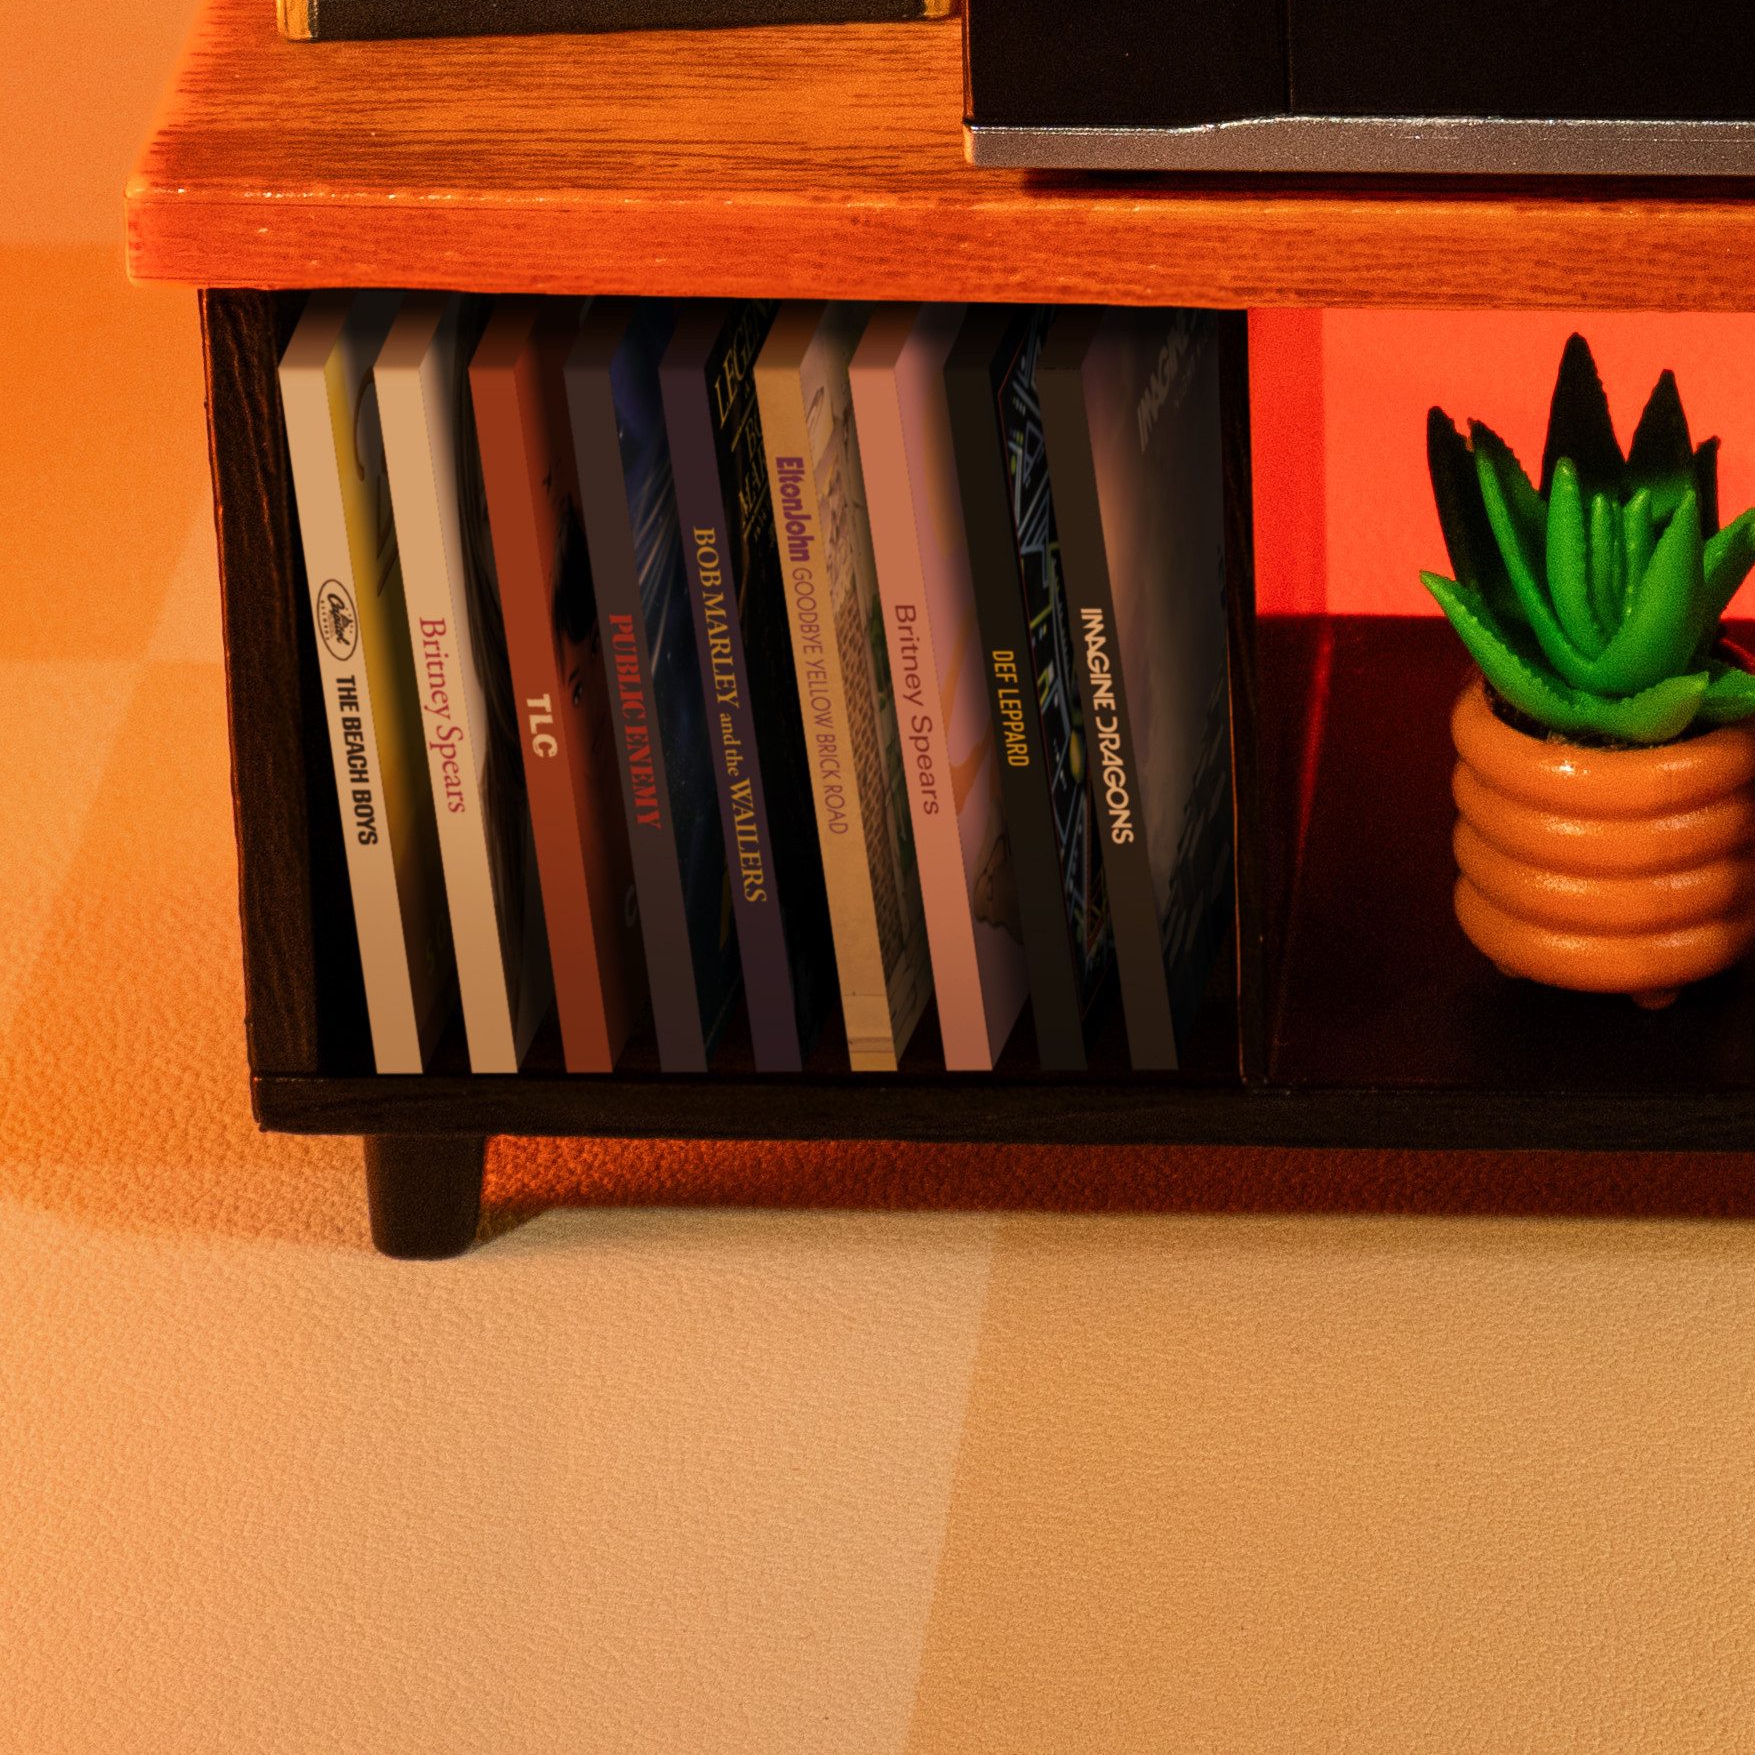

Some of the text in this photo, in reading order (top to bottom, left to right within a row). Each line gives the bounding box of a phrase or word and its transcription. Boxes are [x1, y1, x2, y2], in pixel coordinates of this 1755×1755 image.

[327, 593, 351, 646] Capitol
[792, 566, 823, 654] GOODBYE
[418, 616, 466, 814] Britney Spears
[526, 693, 559, 758] TLC
[608, 614, 662, 830] PUBLIC ENEMY
[693, 526, 768, 903] BOB MARLEY and the WAILERS
[805, 659, 835, 730] YELLOW
[894, 604, 940, 816] Britney Spears
[991, 649, 1031, 767] DEF LEPPARD
[1080, 608, 1135, 845] IMAGINE DRAGONS
[336, 674, 379, 846] THE BEACH BOYS
[815, 733, 841, 780] BRICK
[824, 784, 849, 835] ROAD
